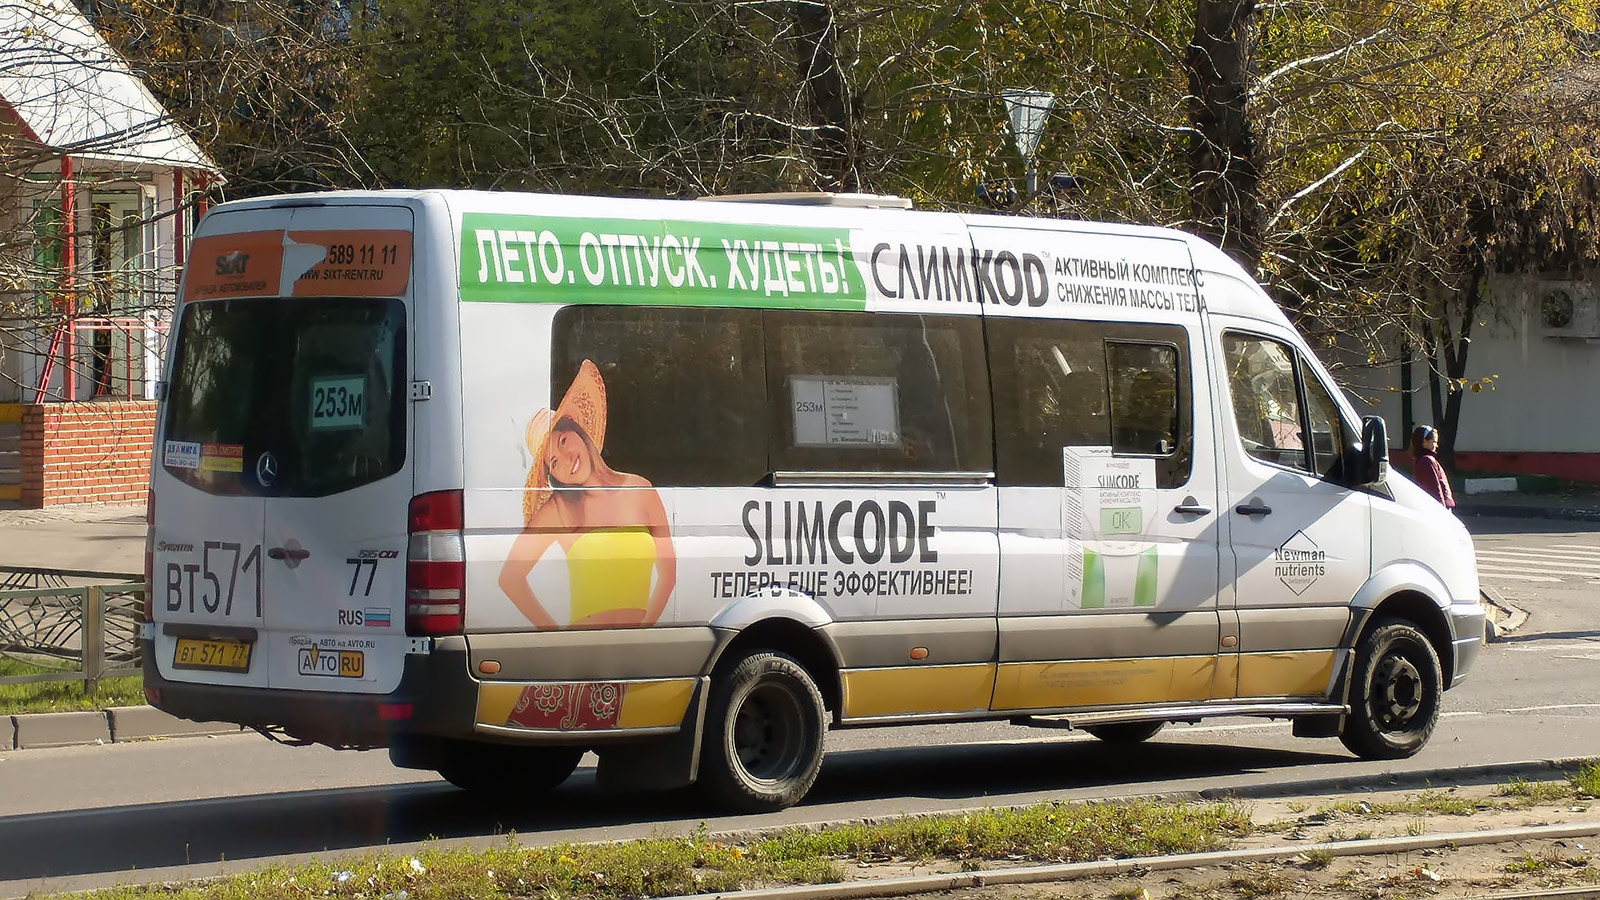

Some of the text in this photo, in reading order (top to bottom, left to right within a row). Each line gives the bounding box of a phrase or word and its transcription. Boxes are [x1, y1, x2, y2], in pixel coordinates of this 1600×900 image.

[329, 243, 397, 265] 589 11 11
[474, 229, 849, 297] ЛЕТО. ОТПУСК. ХУДЕТЬ!
[1055, 256, 1205, 288] АКТИВНЫЙ КОМПЛЕКС
[1057, 282, 1209, 314] СНИЖЕНИЯ МАССЫ ТЕЛА
[1098, 474, 1140, 489] SLIMCODE
[1112, 512, 1131, 529] OK
[742, 500, 938, 566] SLIMCODE
[1275, 548, 1325, 561] Newman
[346, 558, 378, 596] 77
[1274, 563, 1325, 577] nutrients
[711, 569, 973, 599] ТЕПЕРЬ ЕЩЕ ЭФФЕКТИВНЕЕ!
[338, 609, 363, 625] RUS
[319, 638, 336, 647] АВТО
[200, 644, 225, 664] 571
[232, 644, 246, 660] 77
[341, 656, 361, 672] RU
